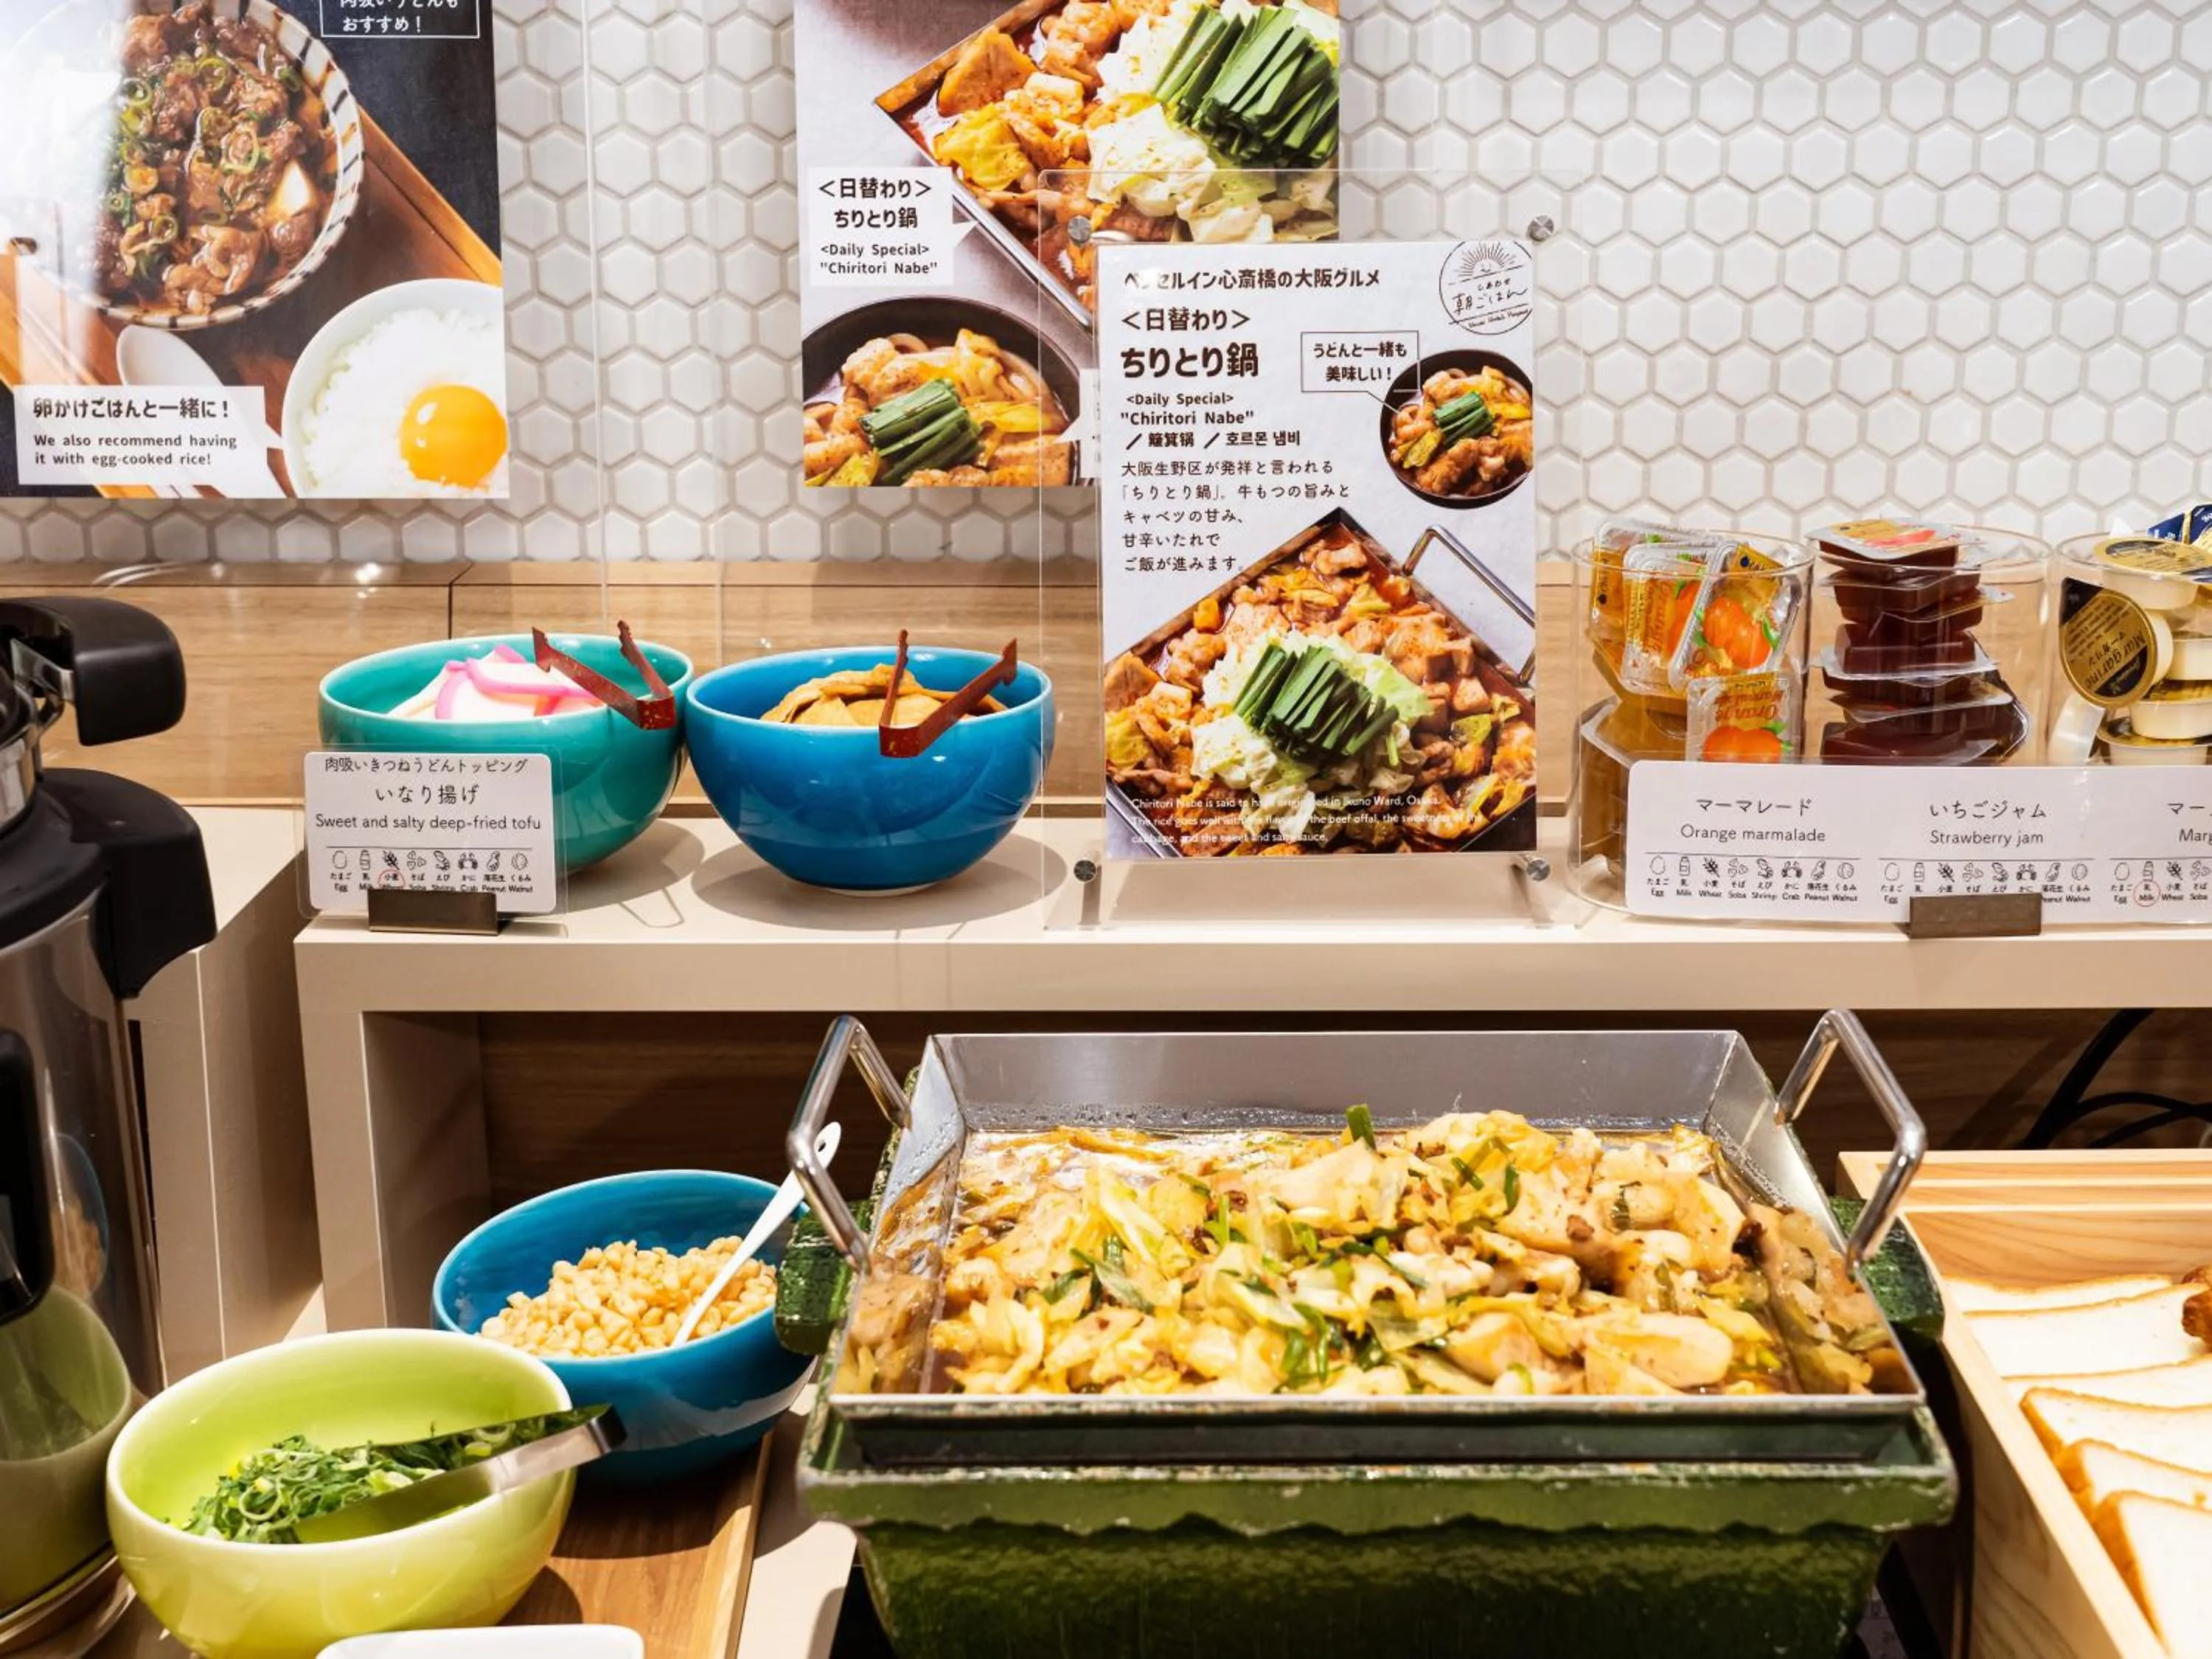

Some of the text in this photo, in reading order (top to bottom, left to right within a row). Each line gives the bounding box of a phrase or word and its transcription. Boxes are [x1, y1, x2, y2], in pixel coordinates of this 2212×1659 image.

[343, 15, 421, 33] おすすめ！
[834, 207, 918, 229] ちりとり鍋
[821, 243, 929, 258] <Daily Special>
[820, 261, 937, 274] "Chiritori Nabe"
[1124, 268, 1380, 290] ベセルイン心斎橋の大阪グルメ
[1313, 341, 1407, 358] うどんと一緒も
[1121, 342, 1259, 378] ちりとり鍋
[1326, 366, 1391, 382] 美味しい！
[1127, 392, 1234, 407] <Daily Special>
[33, 397, 229, 419] 卵かけごはんと一緒に！
[1121, 411, 1254, 425] "Chiritori Nabe"
[34, 434, 237, 449] We also recommend having
[1226, 431, 1267, 447] 호르몬
[1273, 431, 1300, 446] 냄비
[35, 453, 211, 467] it with egg-cooked rice!
[1121, 460, 1333, 476] 大阪生野区が発祥と言われる
[1124, 509, 1243, 524] キャベツの甘み、
[1122, 533, 1220, 548] 甘辛いたれで
[325, 757, 528, 773] 肉吸いきつねうどんトッピング
[376, 785, 479, 805] いなり揚げ
[1206, 799, 1213, 807] is
[1216, 799, 1236, 807] said
[1373, 795, 1404, 806] Ward,
[1696, 798, 1812, 816] マーマレード
[1929, 800, 2047, 819] いちごジャム
[316, 814, 541, 832] Sweet and salty deep-fried tofu
[1328, 814, 1351, 823] beef
[1382, 813, 1399, 823] the
[1680, 824, 1826, 842] Orange marmalade
[1930, 830, 2043, 847] Strawberry jam
